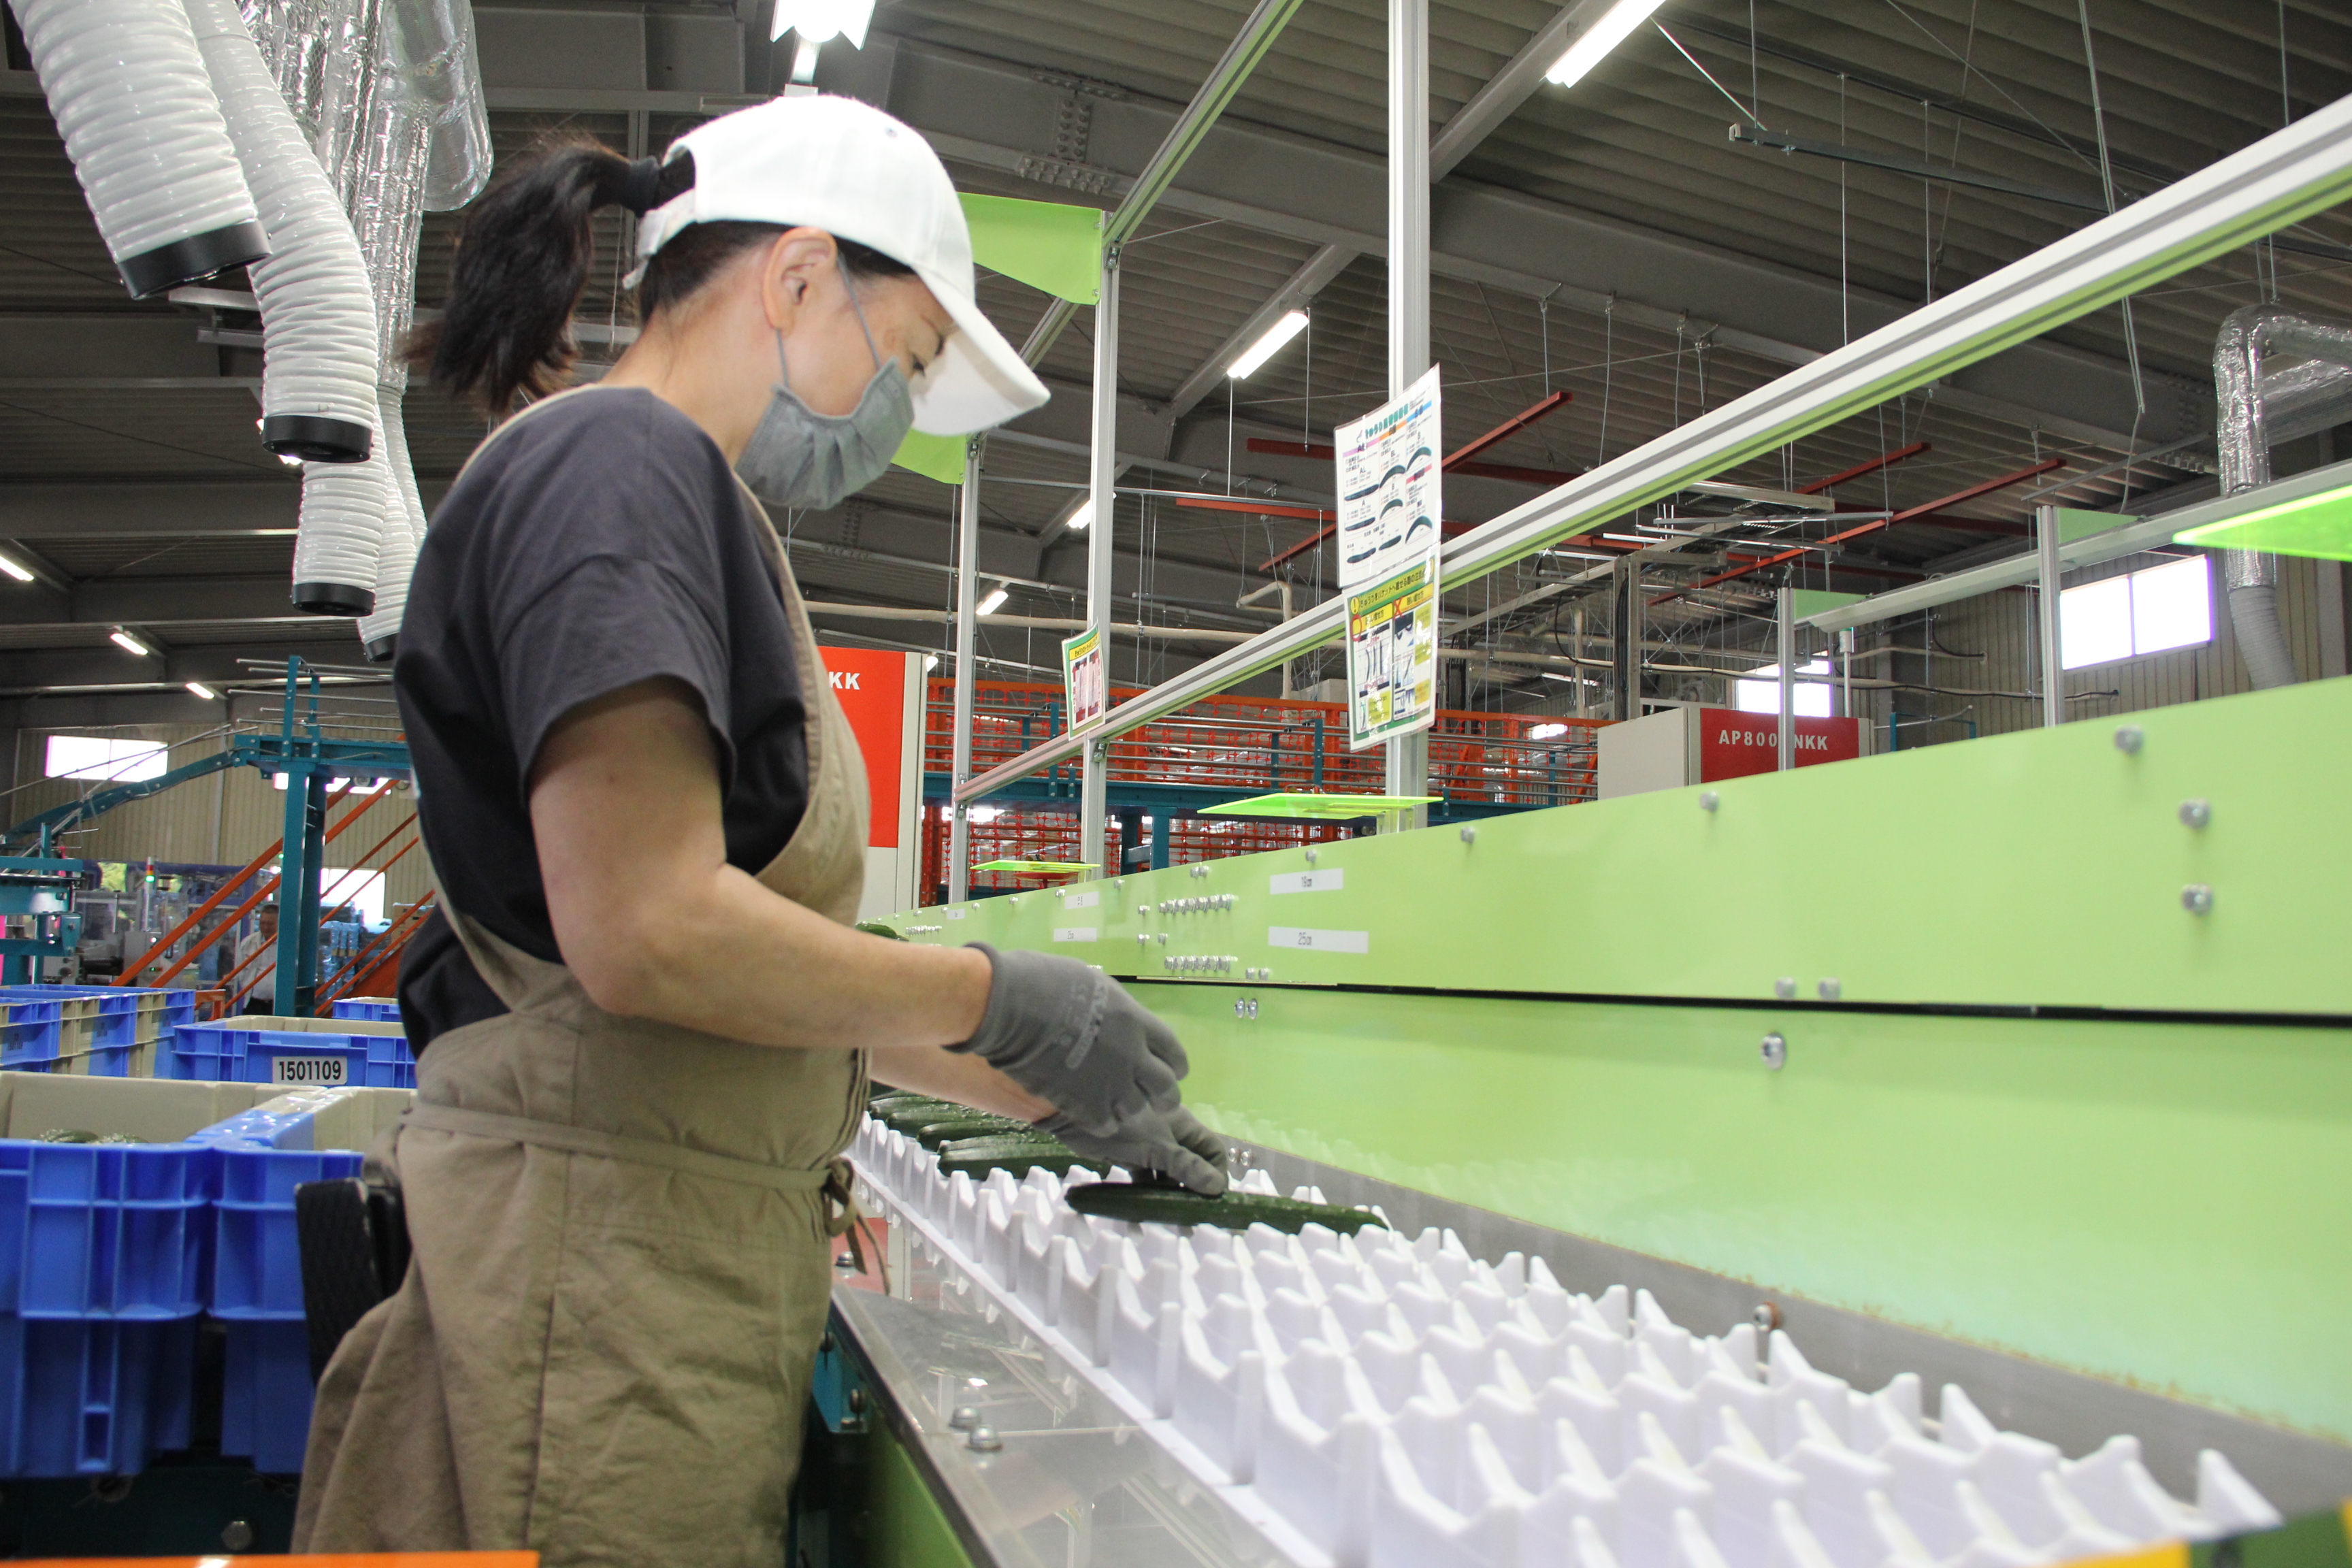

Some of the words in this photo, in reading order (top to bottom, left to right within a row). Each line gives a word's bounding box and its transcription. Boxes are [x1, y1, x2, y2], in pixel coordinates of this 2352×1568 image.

[1718, 730, 1778, 747] AP800
[1795, 734, 1828, 750] NKK
[279, 1060, 342, 1081] 1501109
